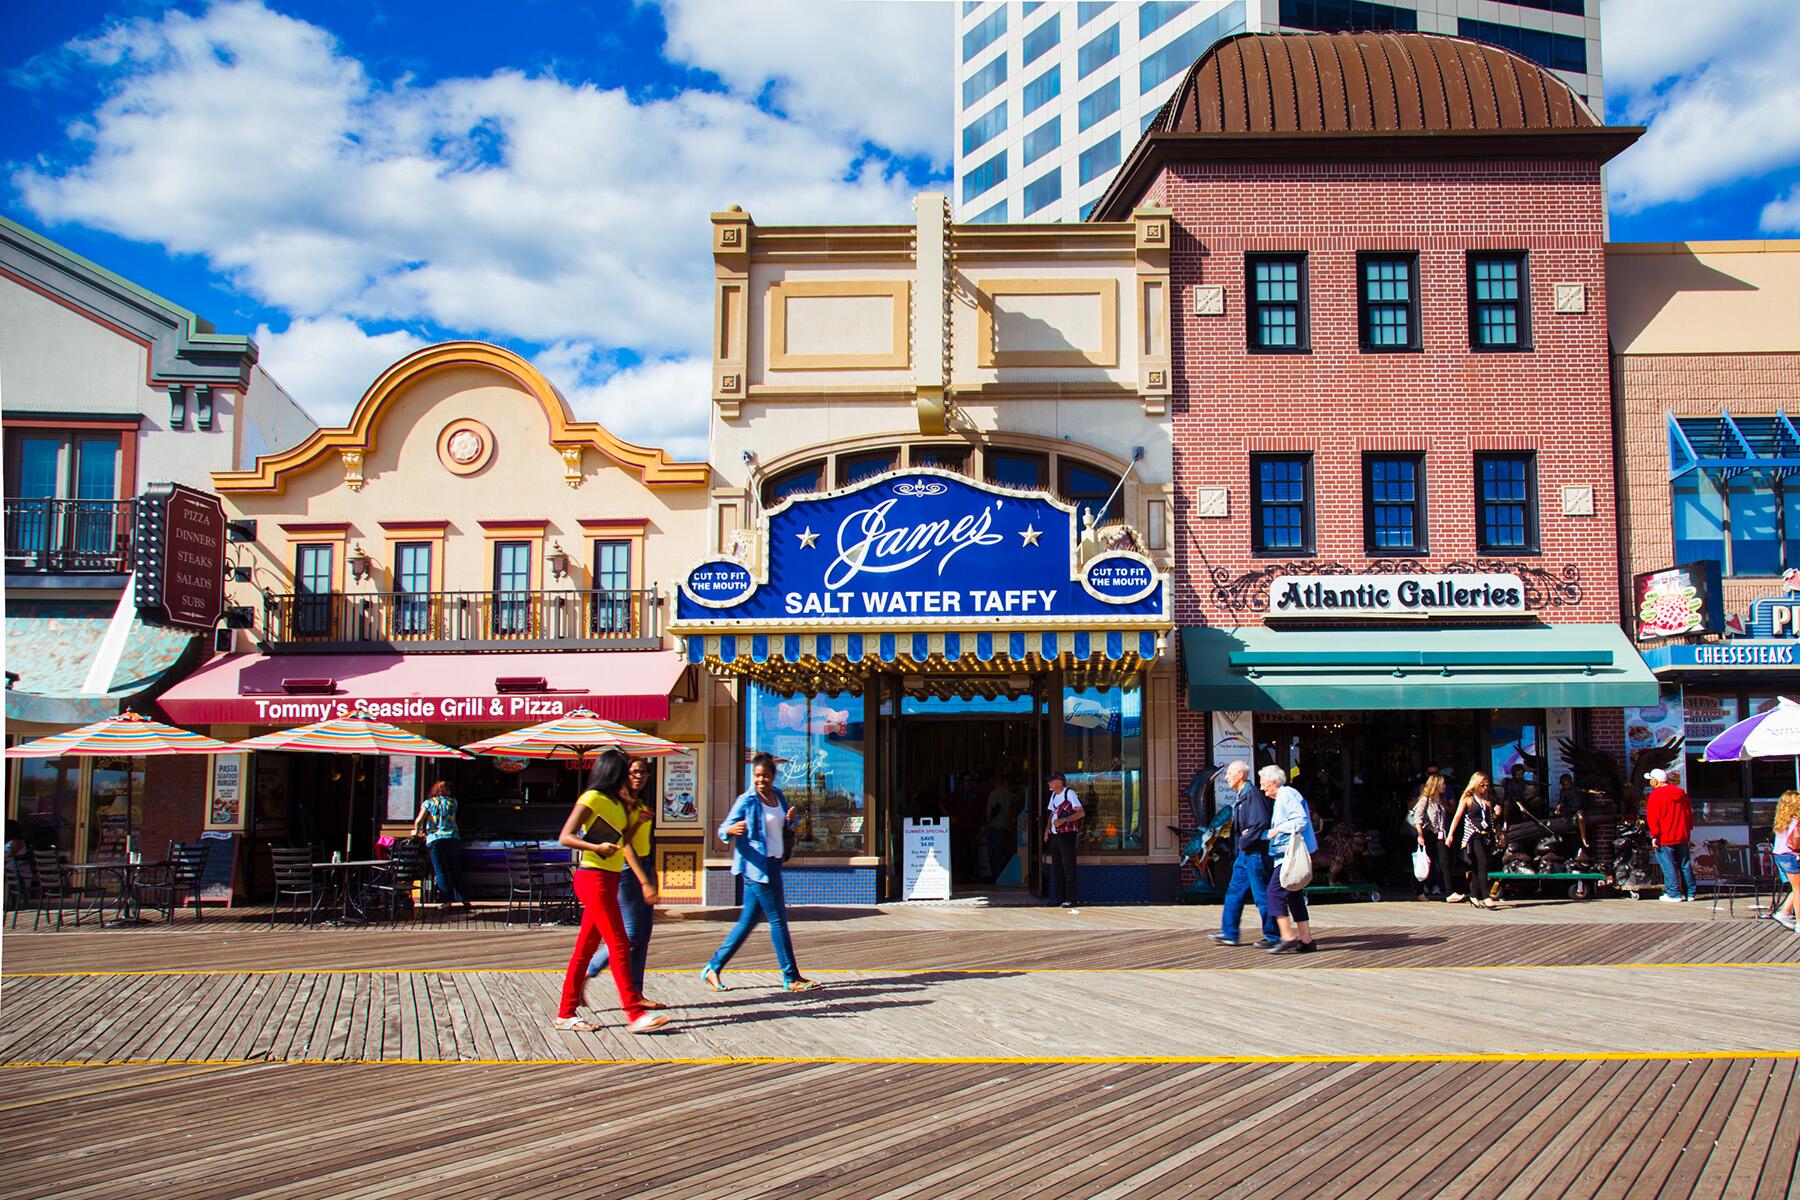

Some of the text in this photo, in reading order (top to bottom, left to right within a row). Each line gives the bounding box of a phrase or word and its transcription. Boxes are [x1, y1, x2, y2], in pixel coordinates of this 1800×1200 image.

[183, 508, 211, 526] PIZZA
[175, 527, 217, 548] DINNERS
[824, 498, 1004, 590] James'
[177, 550, 213, 568] STEAKS
[176, 571, 213, 589] SALADS
[693, 572, 746, 580] CUT TO FIT
[1092, 568, 1145, 576] CUT TO FIT
[691, 582, 747, 590] THE MOUTH
[1091, 578, 1147, 586] THE MOUTH
[182, 594, 206, 609] SUBS
[785, 590, 1058, 614] SALT WATER TAFFY
[1277, 580, 1521, 609] Atlantic Galleries
[1694, 646, 1793, 664] CHEESESTEAKS
[255, 697, 564, 721] Tommy's Seaside Grill & Pizza
[218, 765, 237, 773] PASTA
